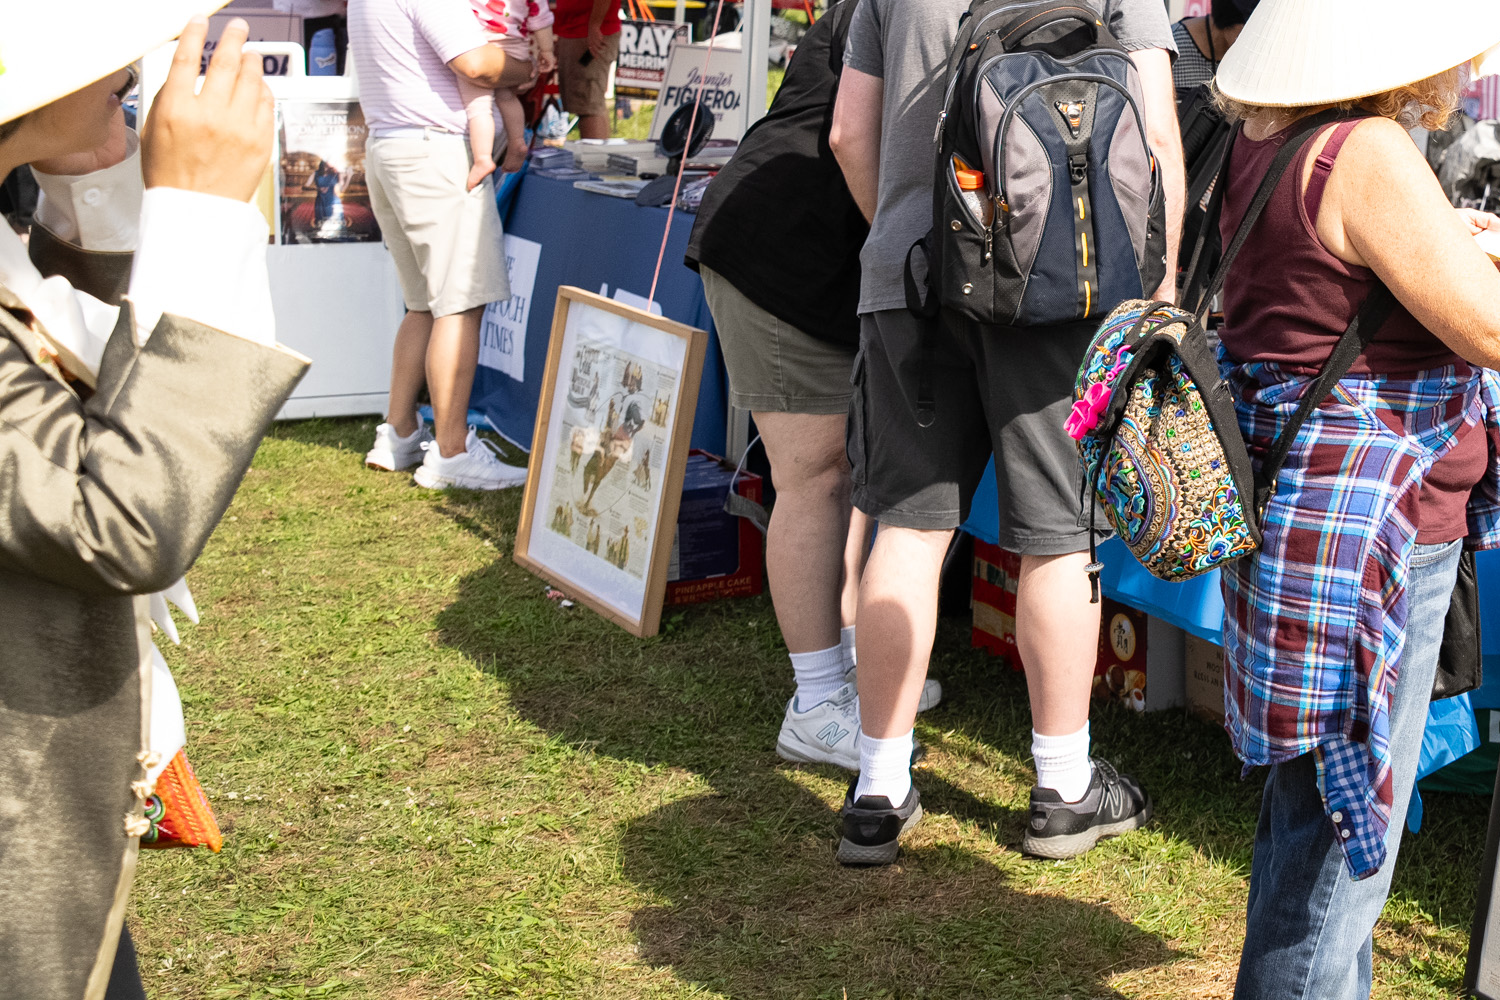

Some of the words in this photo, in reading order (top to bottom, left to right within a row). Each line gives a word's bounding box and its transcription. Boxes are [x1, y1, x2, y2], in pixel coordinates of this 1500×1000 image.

[620, 24, 675, 57] RAY
[619, 53, 668, 70] MERRIM
[675, 581, 725, 594] PINEAPPLE
[727, 576, 751, 588] CAKE
